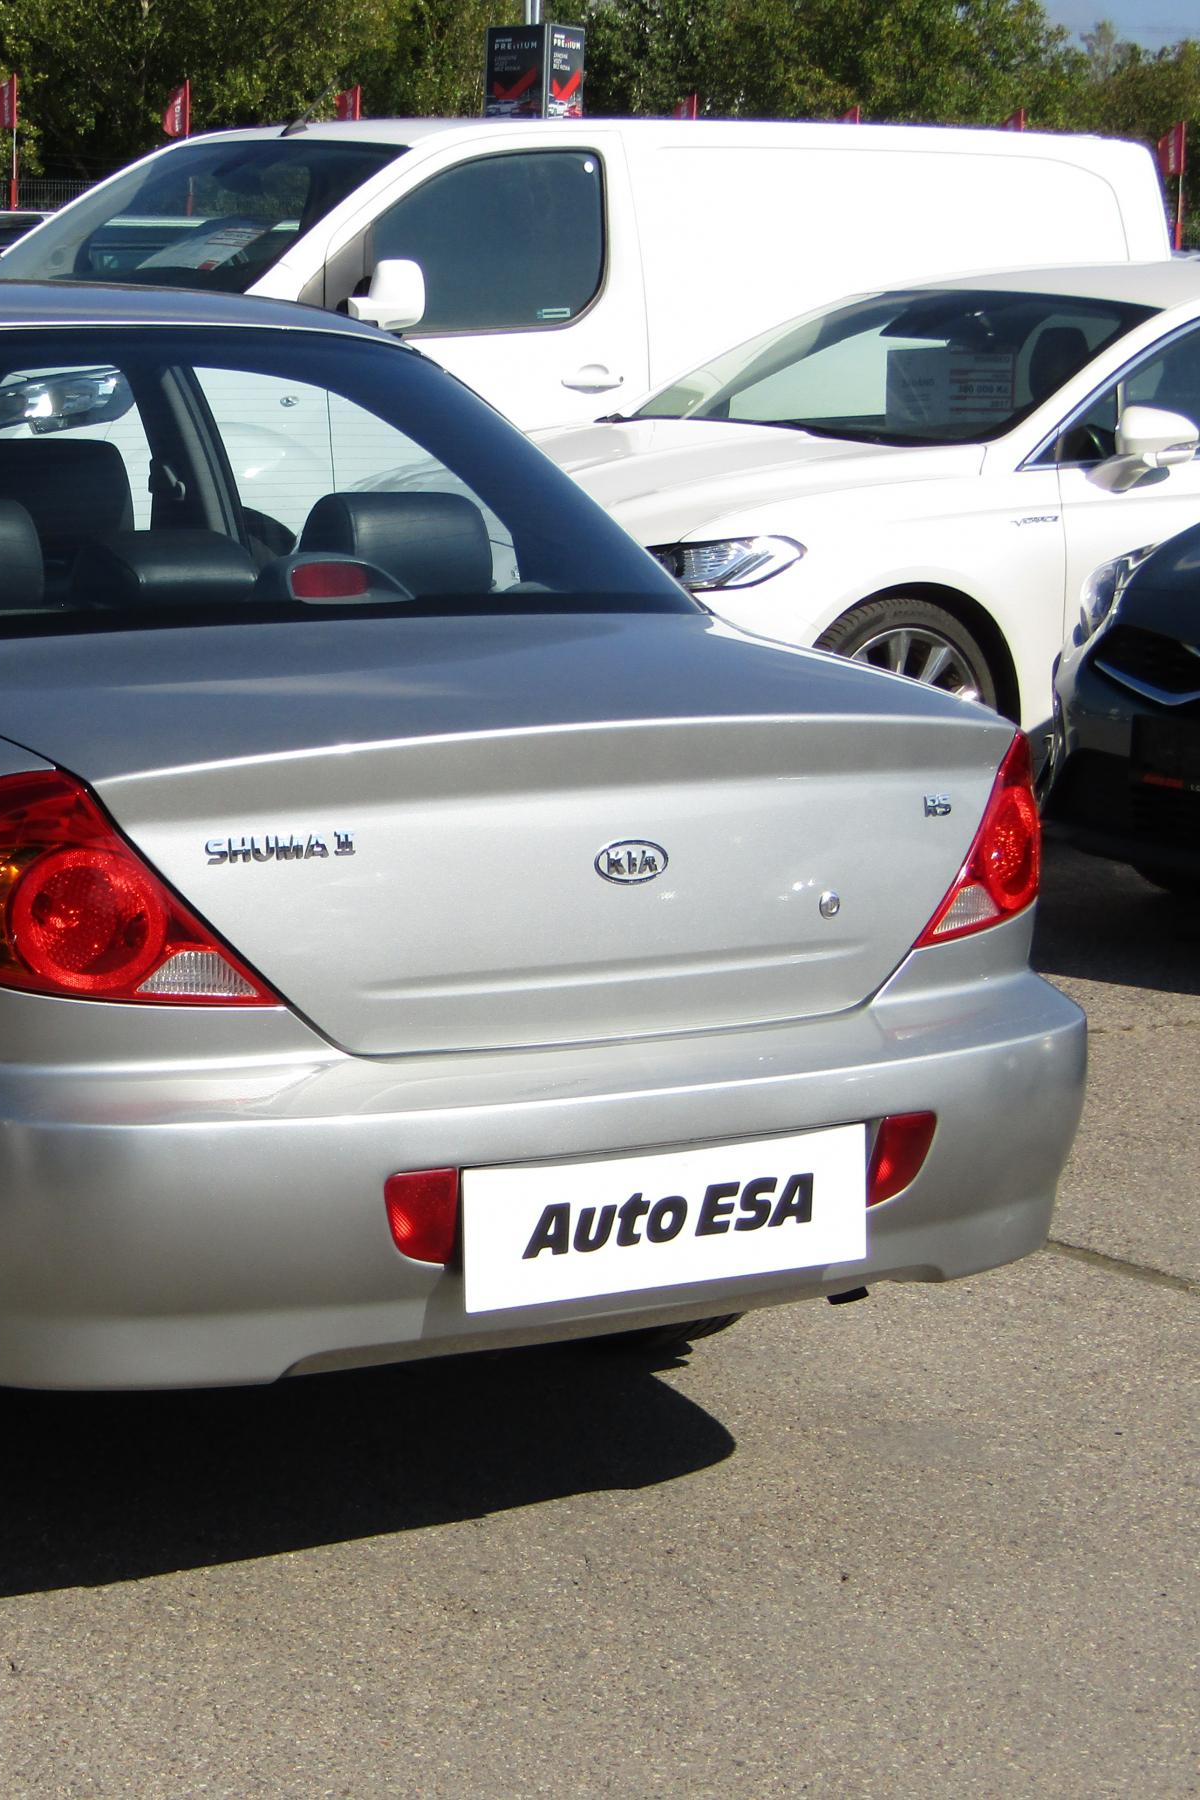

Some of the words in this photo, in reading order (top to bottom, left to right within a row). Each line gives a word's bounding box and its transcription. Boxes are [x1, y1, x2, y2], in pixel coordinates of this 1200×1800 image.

[205, 834, 329, 865] SHUMA
[333, 831, 356, 857] II
[605, 849, 659, 875] KIA
[522, 1192, 688, 1260] Auto
[694, 1172, 815, 1238] ESA
